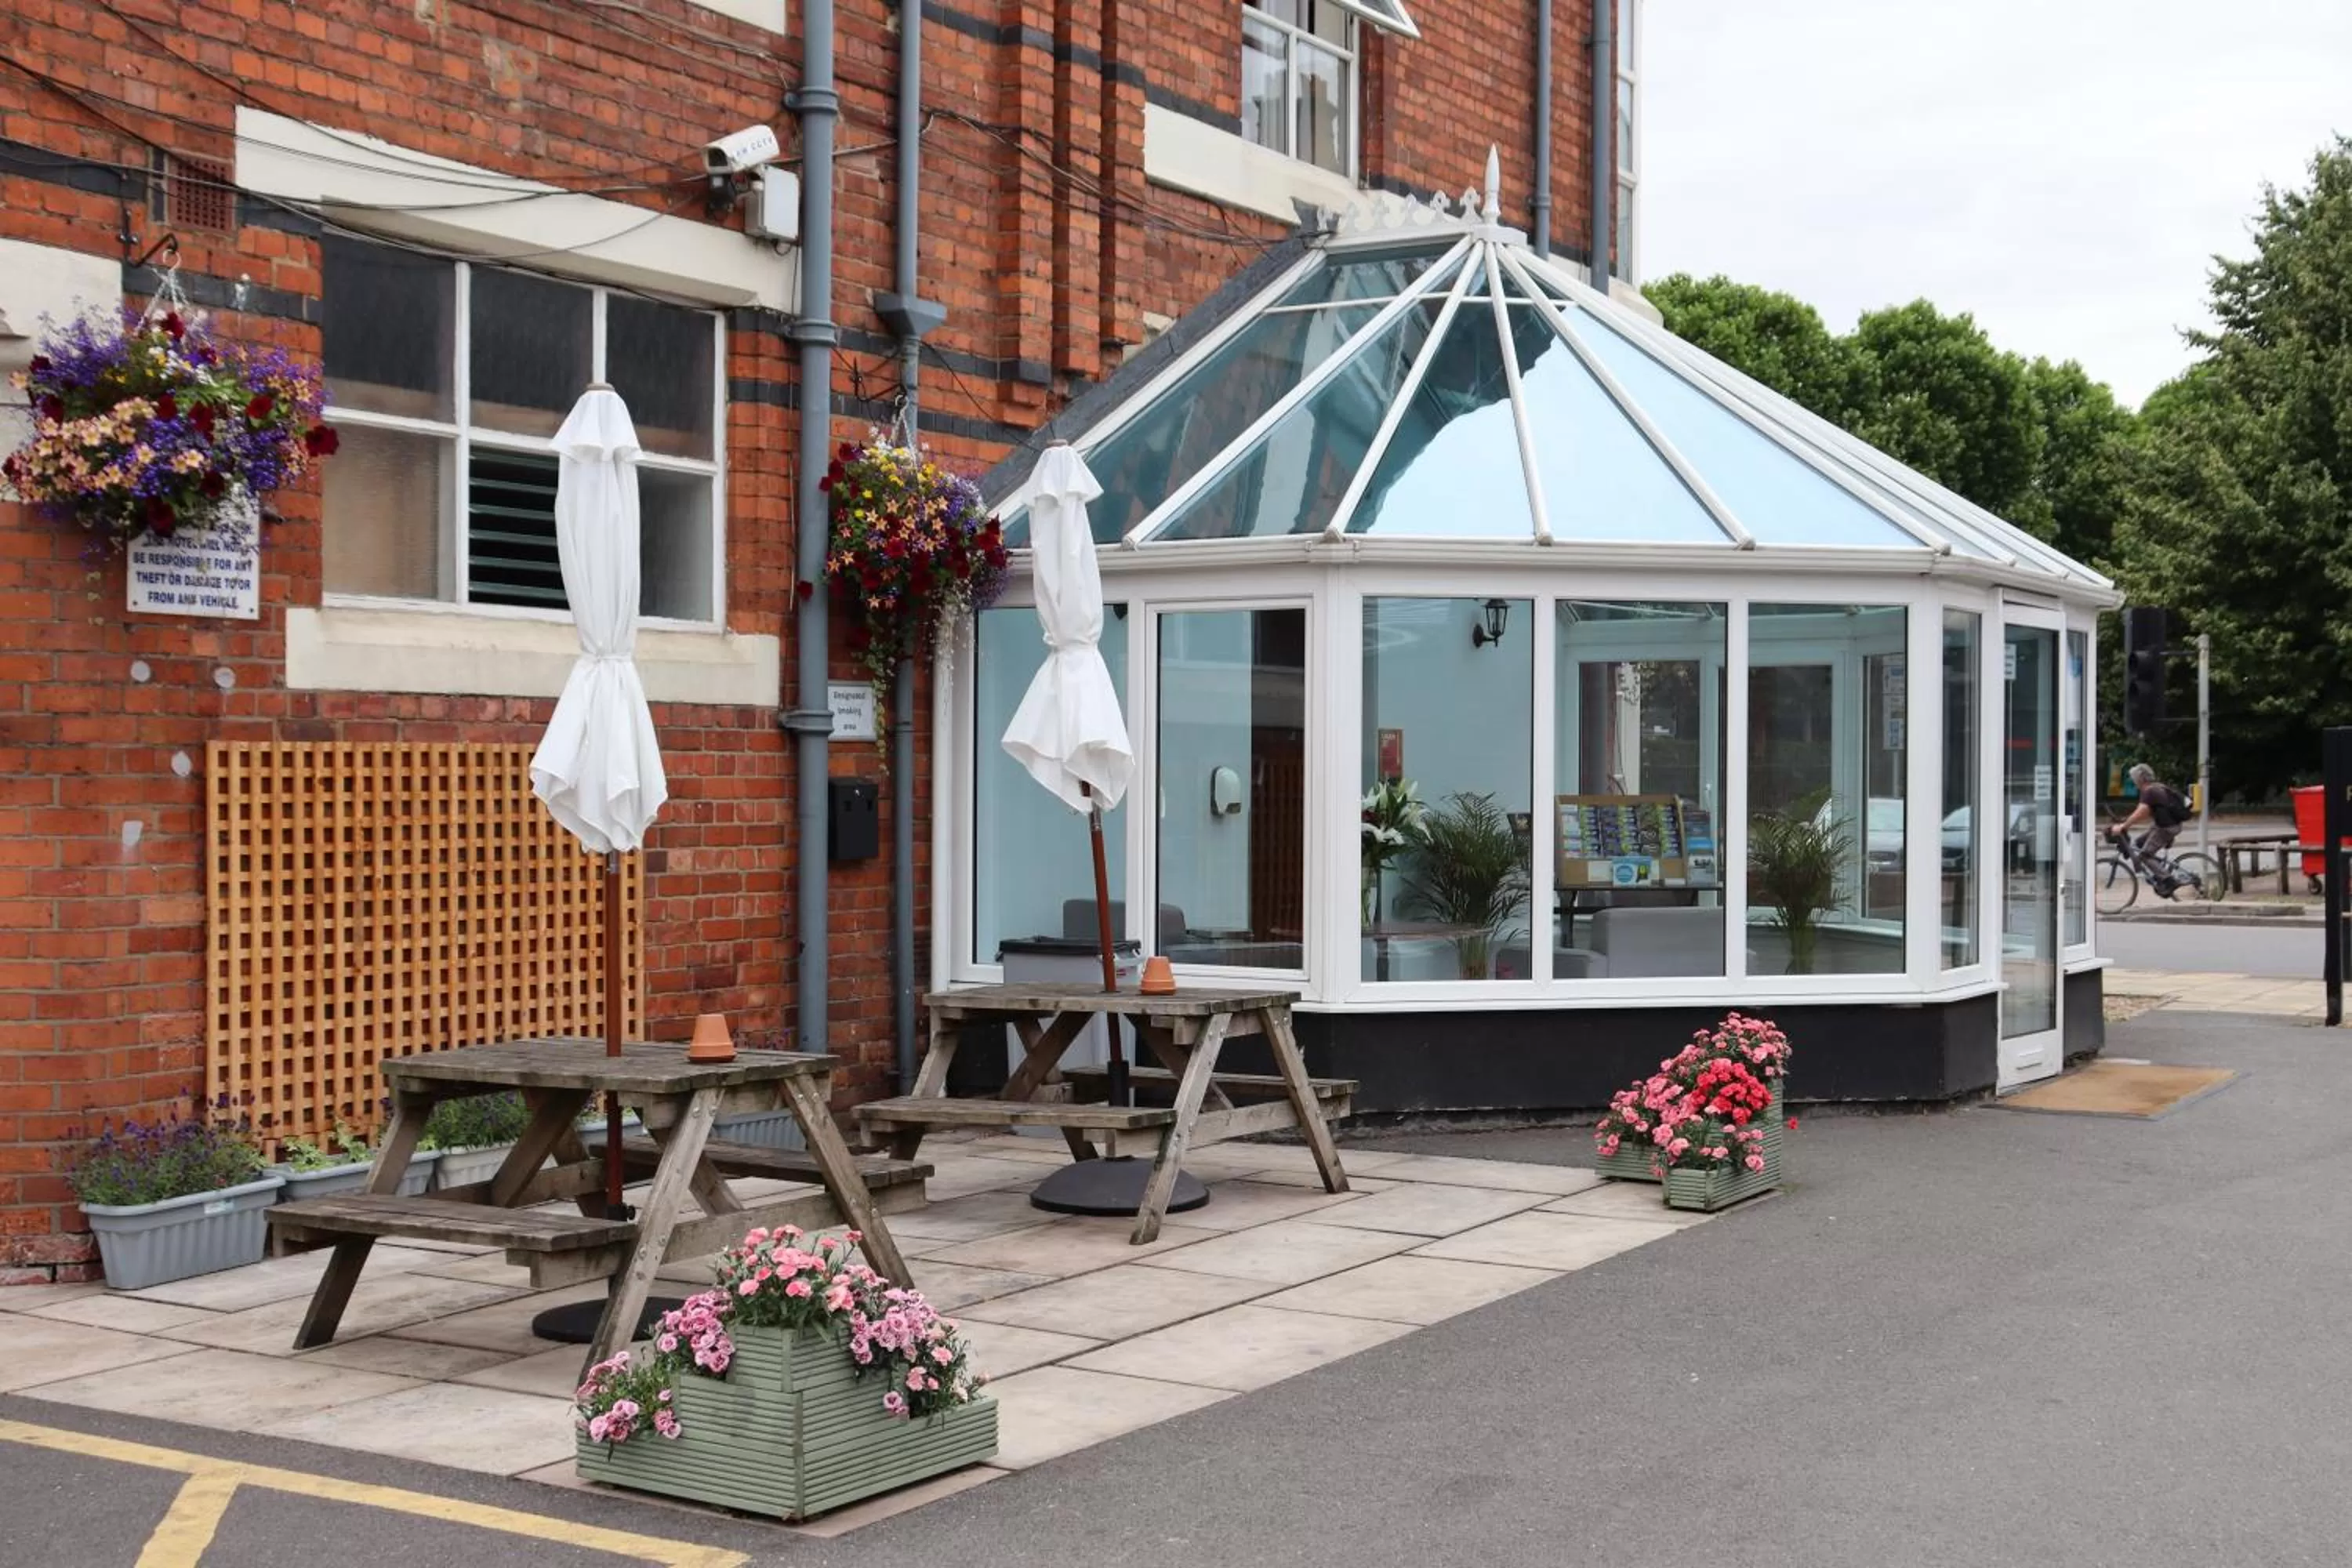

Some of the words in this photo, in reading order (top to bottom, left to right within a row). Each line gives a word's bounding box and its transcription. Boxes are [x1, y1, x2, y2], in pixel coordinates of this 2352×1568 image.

[132, 552, 145, 564] BE
[148, 554, 211, 570] RESPONSIBE
[214, 557, 231, 570] FOR
[235, 560, 252, 572] ANY
[136, 571, 166, 584] THEFT
[169, 574, 182, 586] OR
[184, 576, 222, 588] DAMAGE
[225, 578, 237, 589] TO
[238, 579, 251, 590] OR
[148, 591, 175, 604] FROM
[178, 593, 196, 604] ANY
